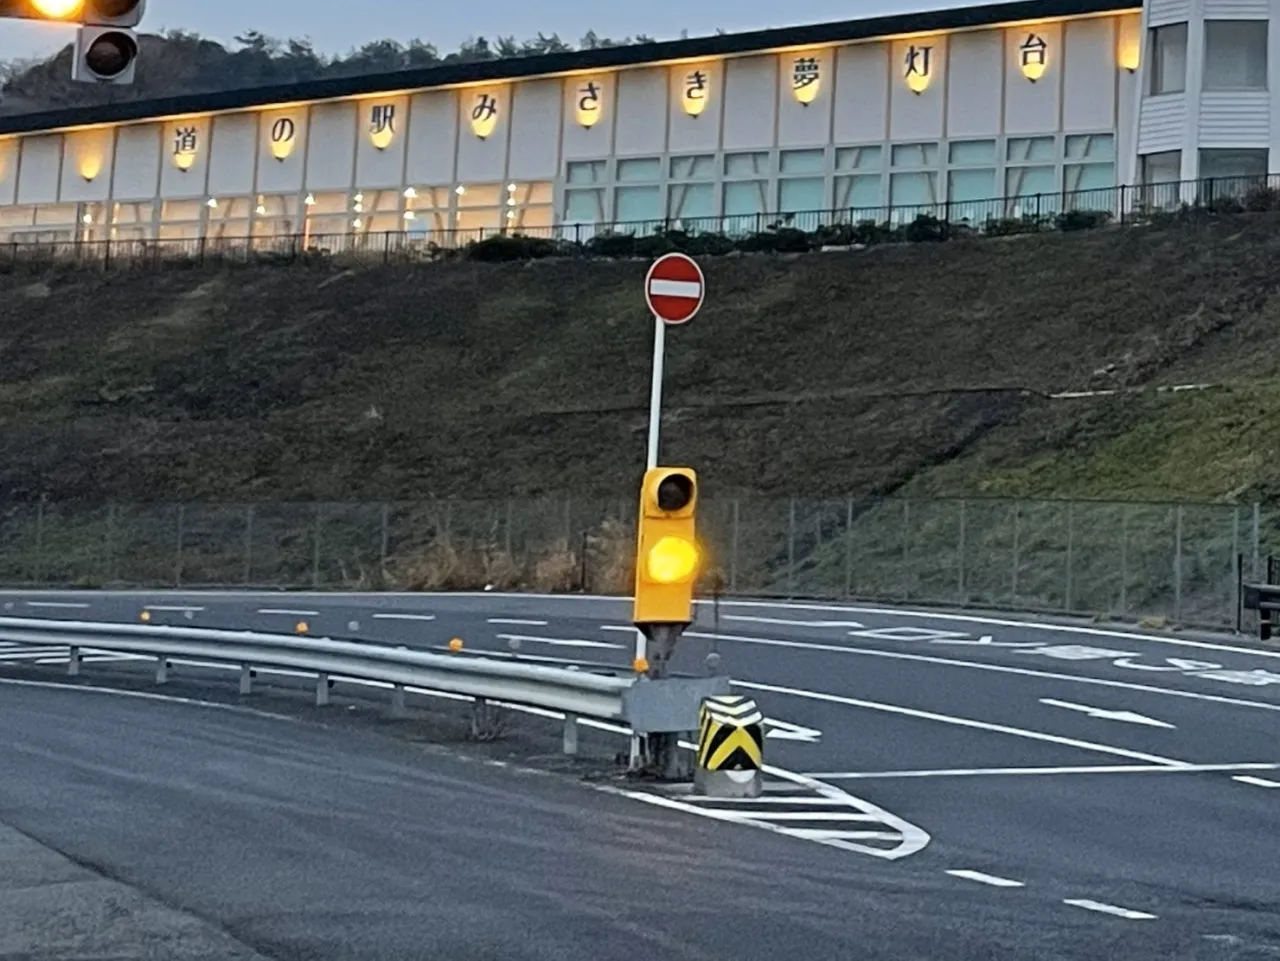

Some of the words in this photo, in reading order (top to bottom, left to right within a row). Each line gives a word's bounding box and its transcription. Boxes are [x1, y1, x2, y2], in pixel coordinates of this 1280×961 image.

[173, 32, 1048, 156] 道の駅みさき夢灯台
